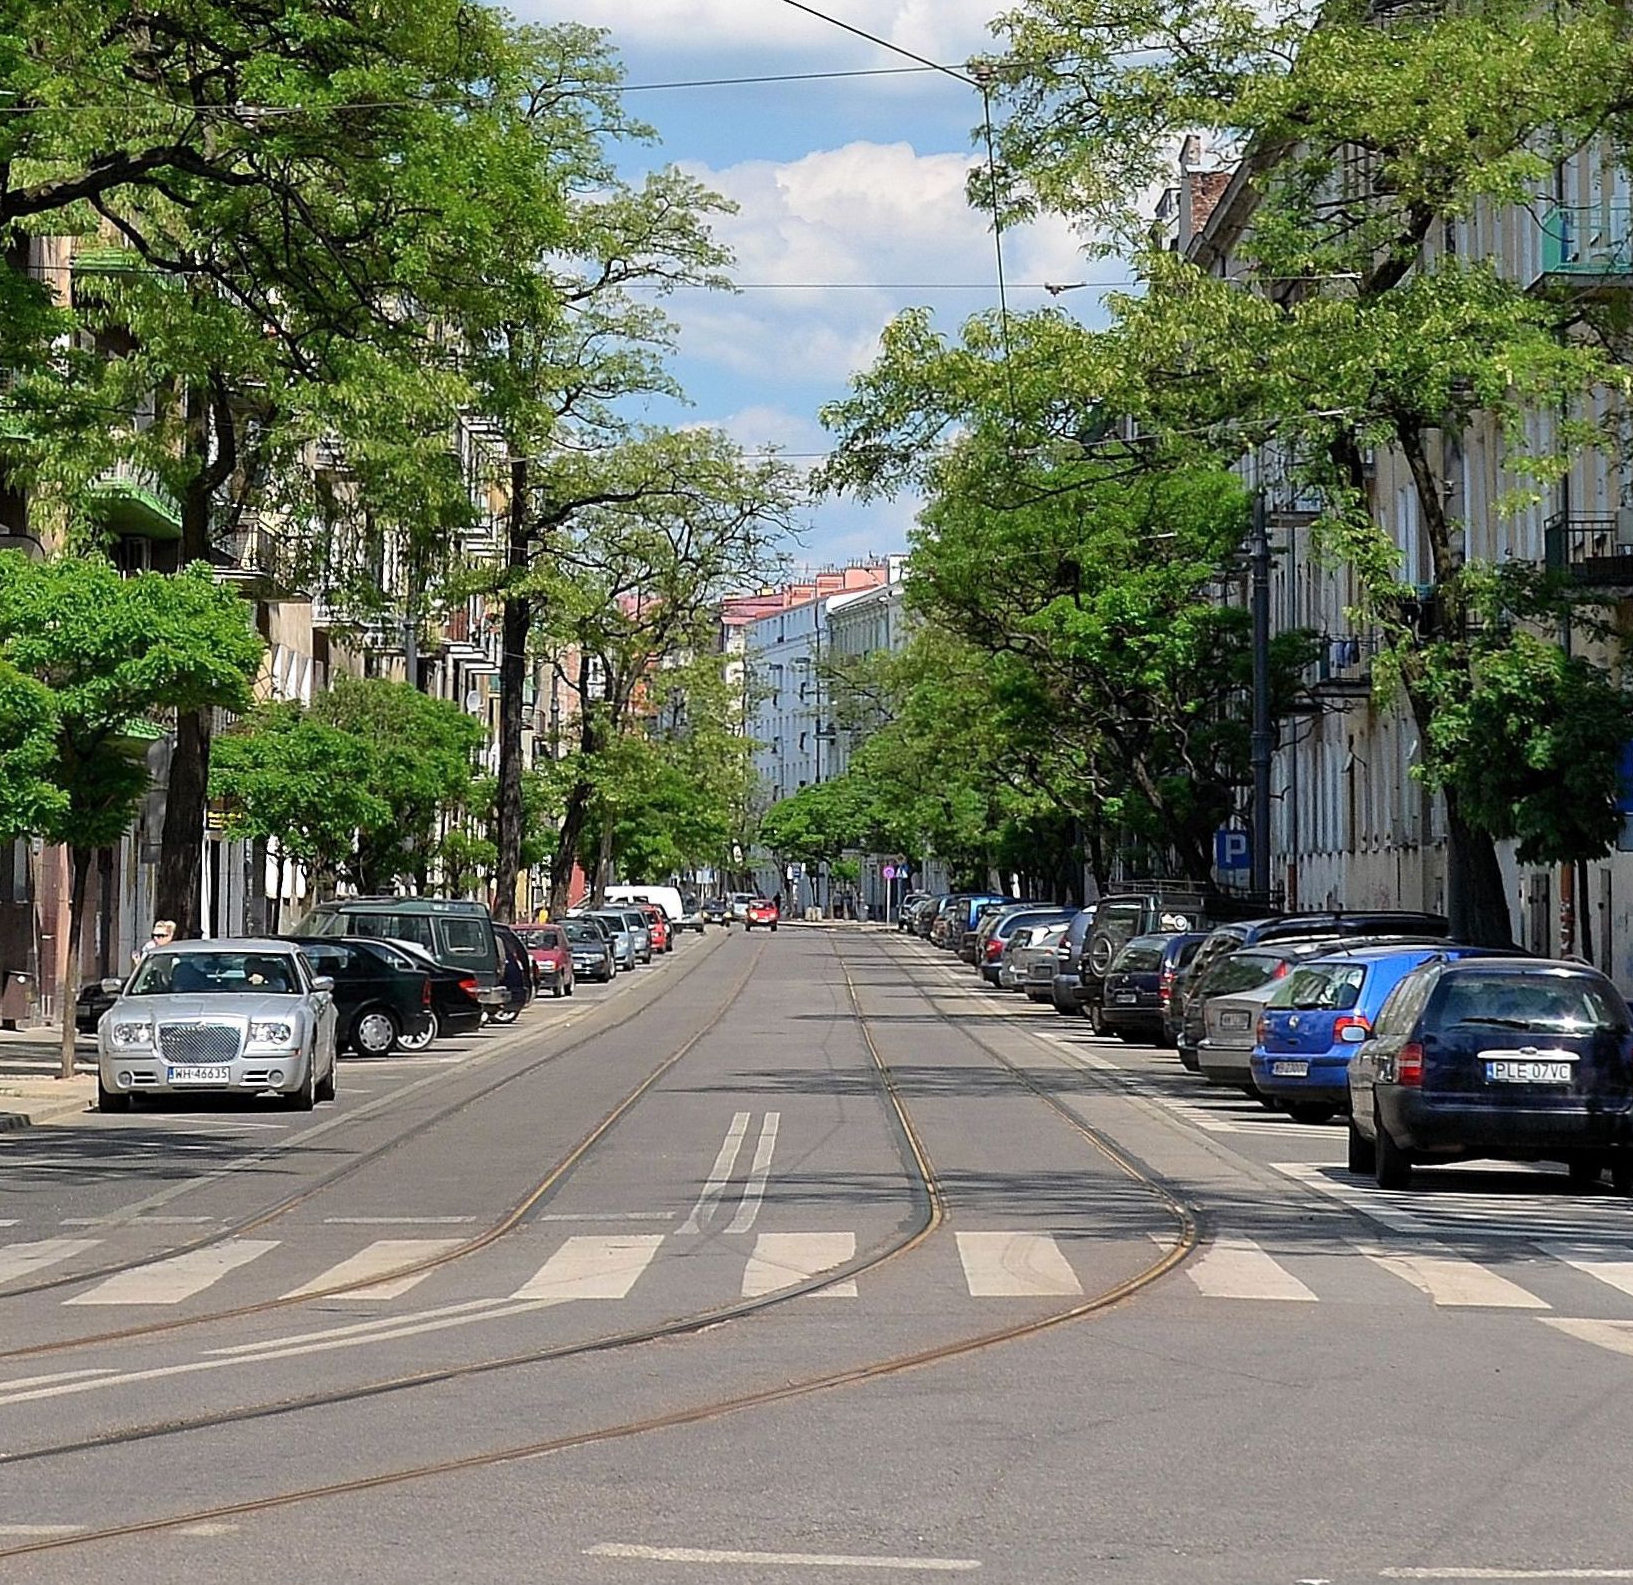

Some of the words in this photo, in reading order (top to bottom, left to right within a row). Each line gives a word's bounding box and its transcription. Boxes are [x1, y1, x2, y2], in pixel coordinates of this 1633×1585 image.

[1226, 834, 1246, 863] P
[175, 1069, 191, 1079] WH
[1496, 1062, 1527, 1078] PLE
[1532, 1063, 1568, 1079] 07VC
